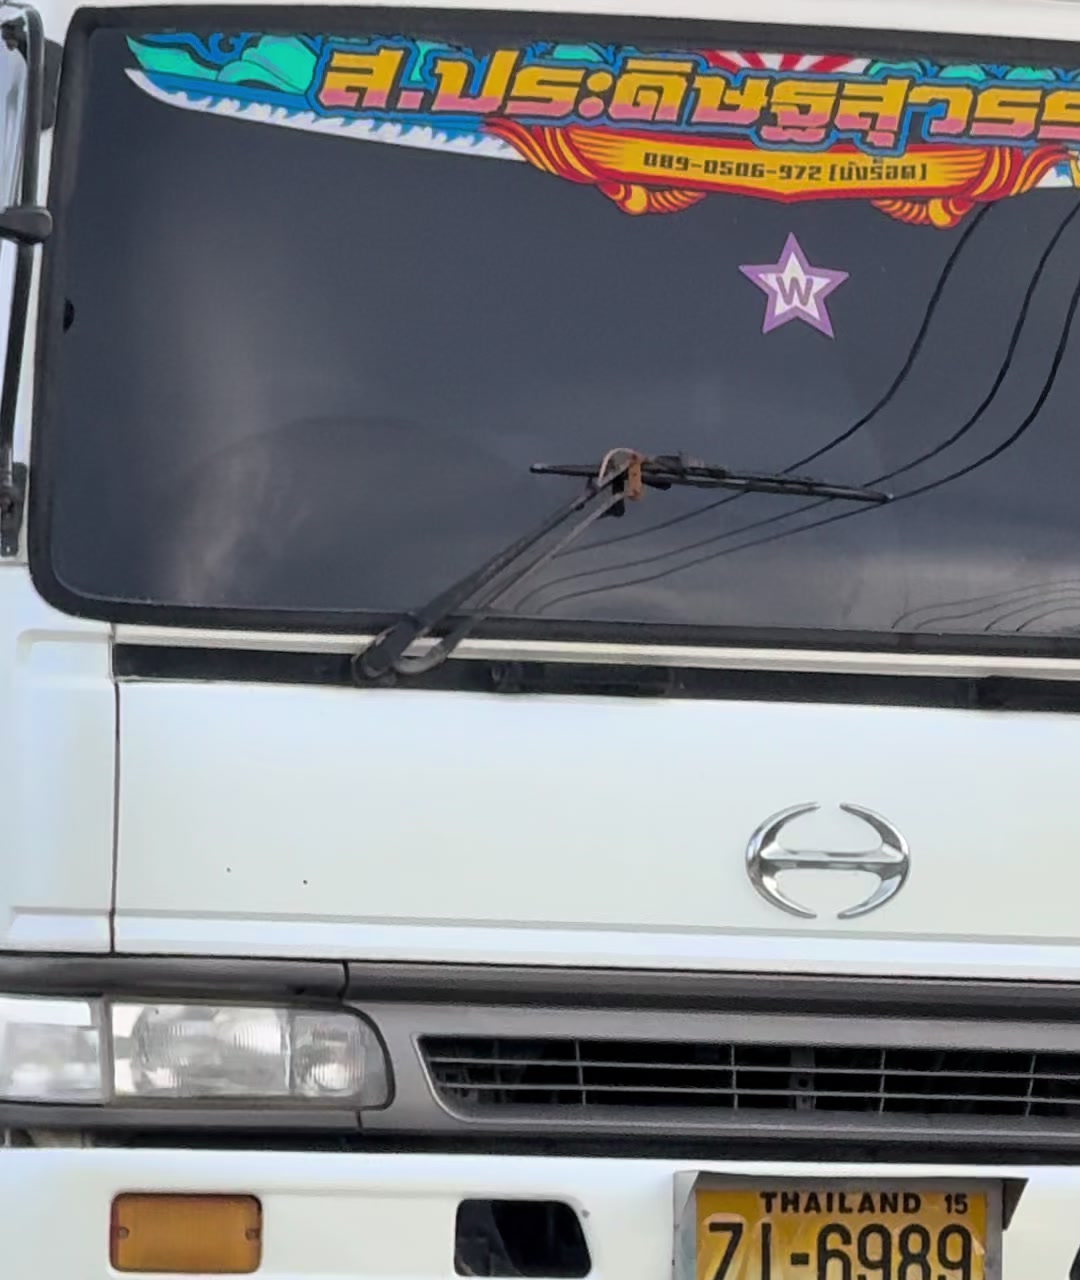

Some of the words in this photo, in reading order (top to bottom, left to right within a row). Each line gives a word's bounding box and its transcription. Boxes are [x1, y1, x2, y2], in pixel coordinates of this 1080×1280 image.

[643, 152, 822, 181] 089-0506-972
[776, 276, 814, 306] W
[760, 1192, 921, 1214] THAILAND
[945, 1193, 968, 1215] 15
